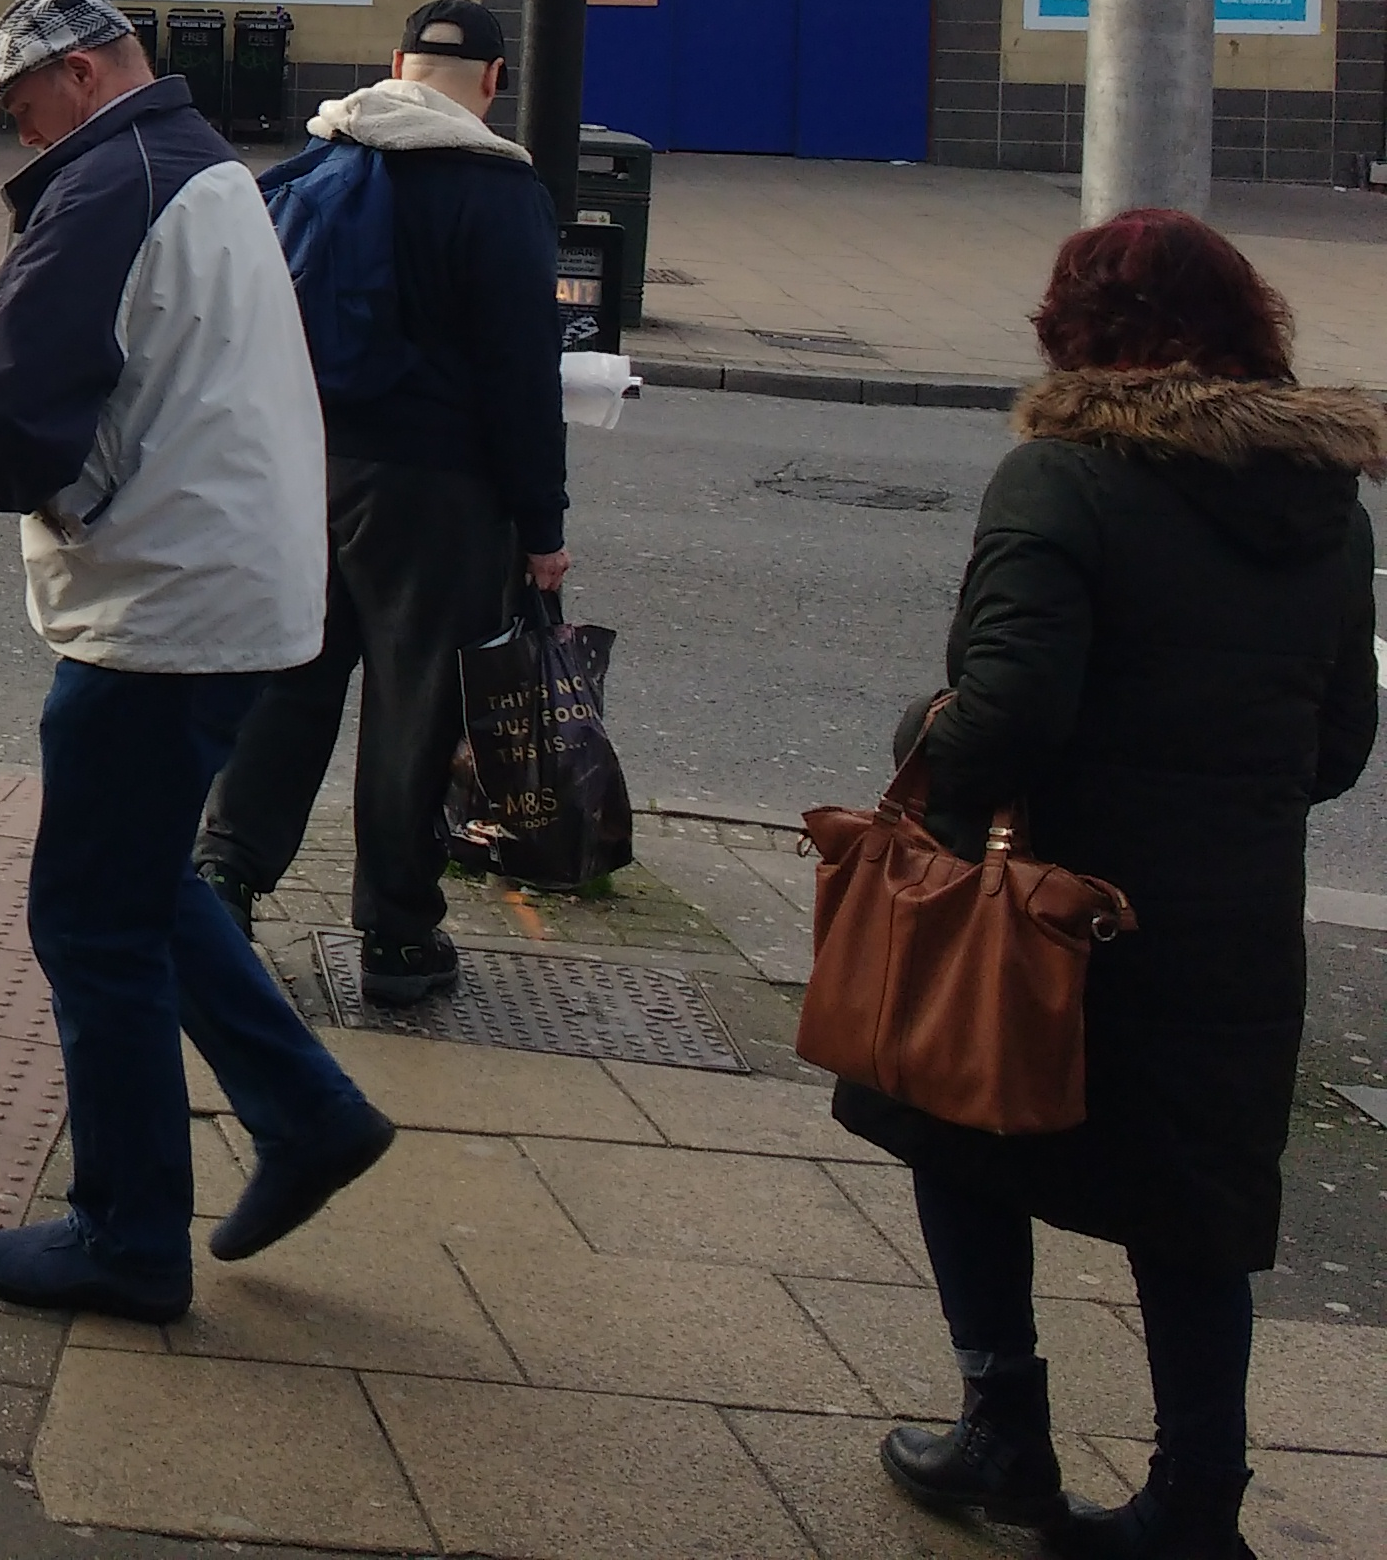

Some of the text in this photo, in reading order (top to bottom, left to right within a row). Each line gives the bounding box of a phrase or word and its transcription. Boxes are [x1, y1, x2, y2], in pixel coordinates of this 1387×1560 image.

[182, 32, 208, 43] FREE
[556, 279, 599, 304] AIT
[506, 787, 558, 816] M&S
